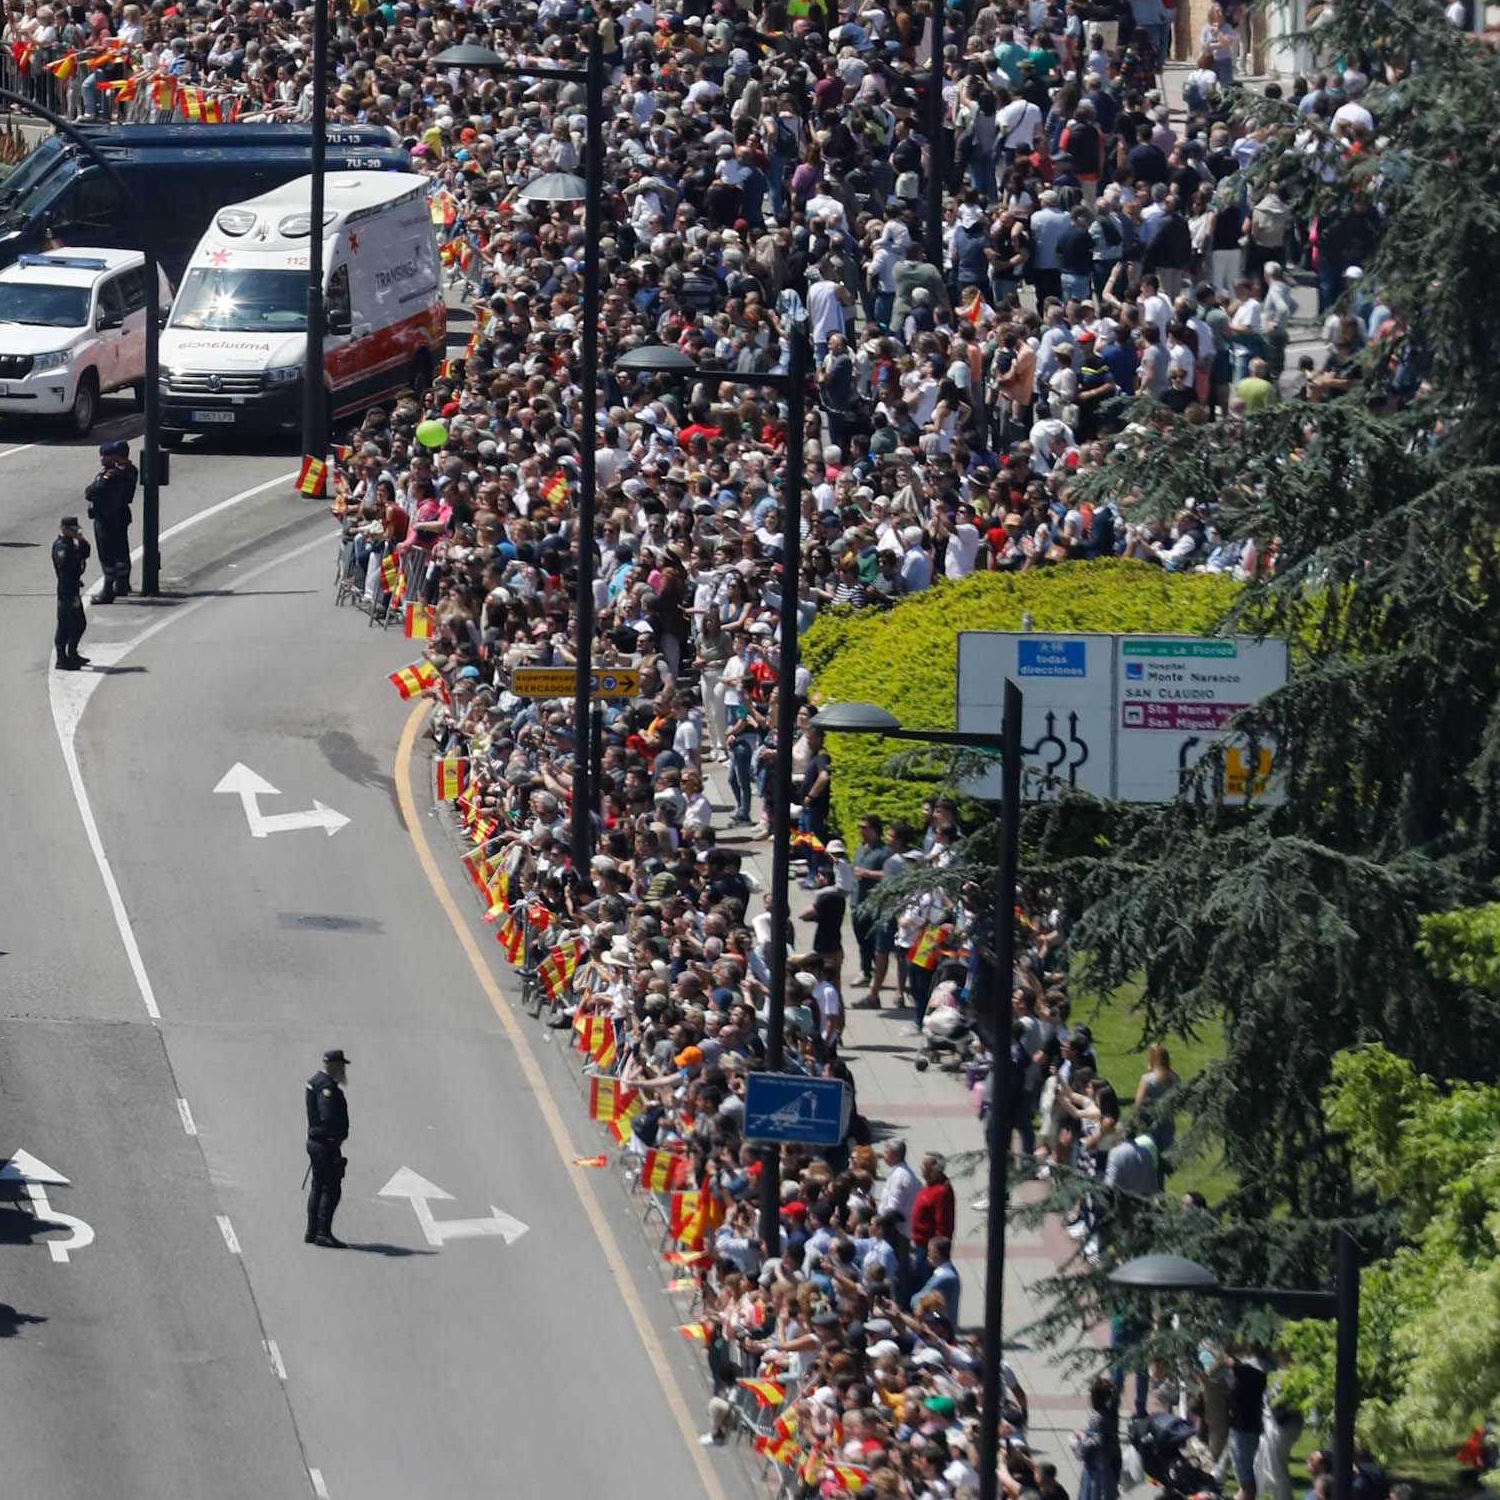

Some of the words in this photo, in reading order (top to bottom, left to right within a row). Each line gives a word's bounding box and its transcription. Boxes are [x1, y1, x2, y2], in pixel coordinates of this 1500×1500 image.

[285, 256, 308, 266] 112
[1173, 646, 1186, 655] La
[1036, 655, 1067, 663] todas
[1020, 665, 1084, 675] direcciones
[1148, 663, 1185, 671] Hospital
[516, 674, 576, 684] supermercad
[1148, 673, 1183, 682] Monte
[1191, 674, 1241, 683] Naranco
[1125, 688, 1151, 697] SAN
[1158, 688, 1215, 699] CLAUDIO
[1147, 718, 1171, 728] San
[1176, 718, 1216, 731] Miguel
